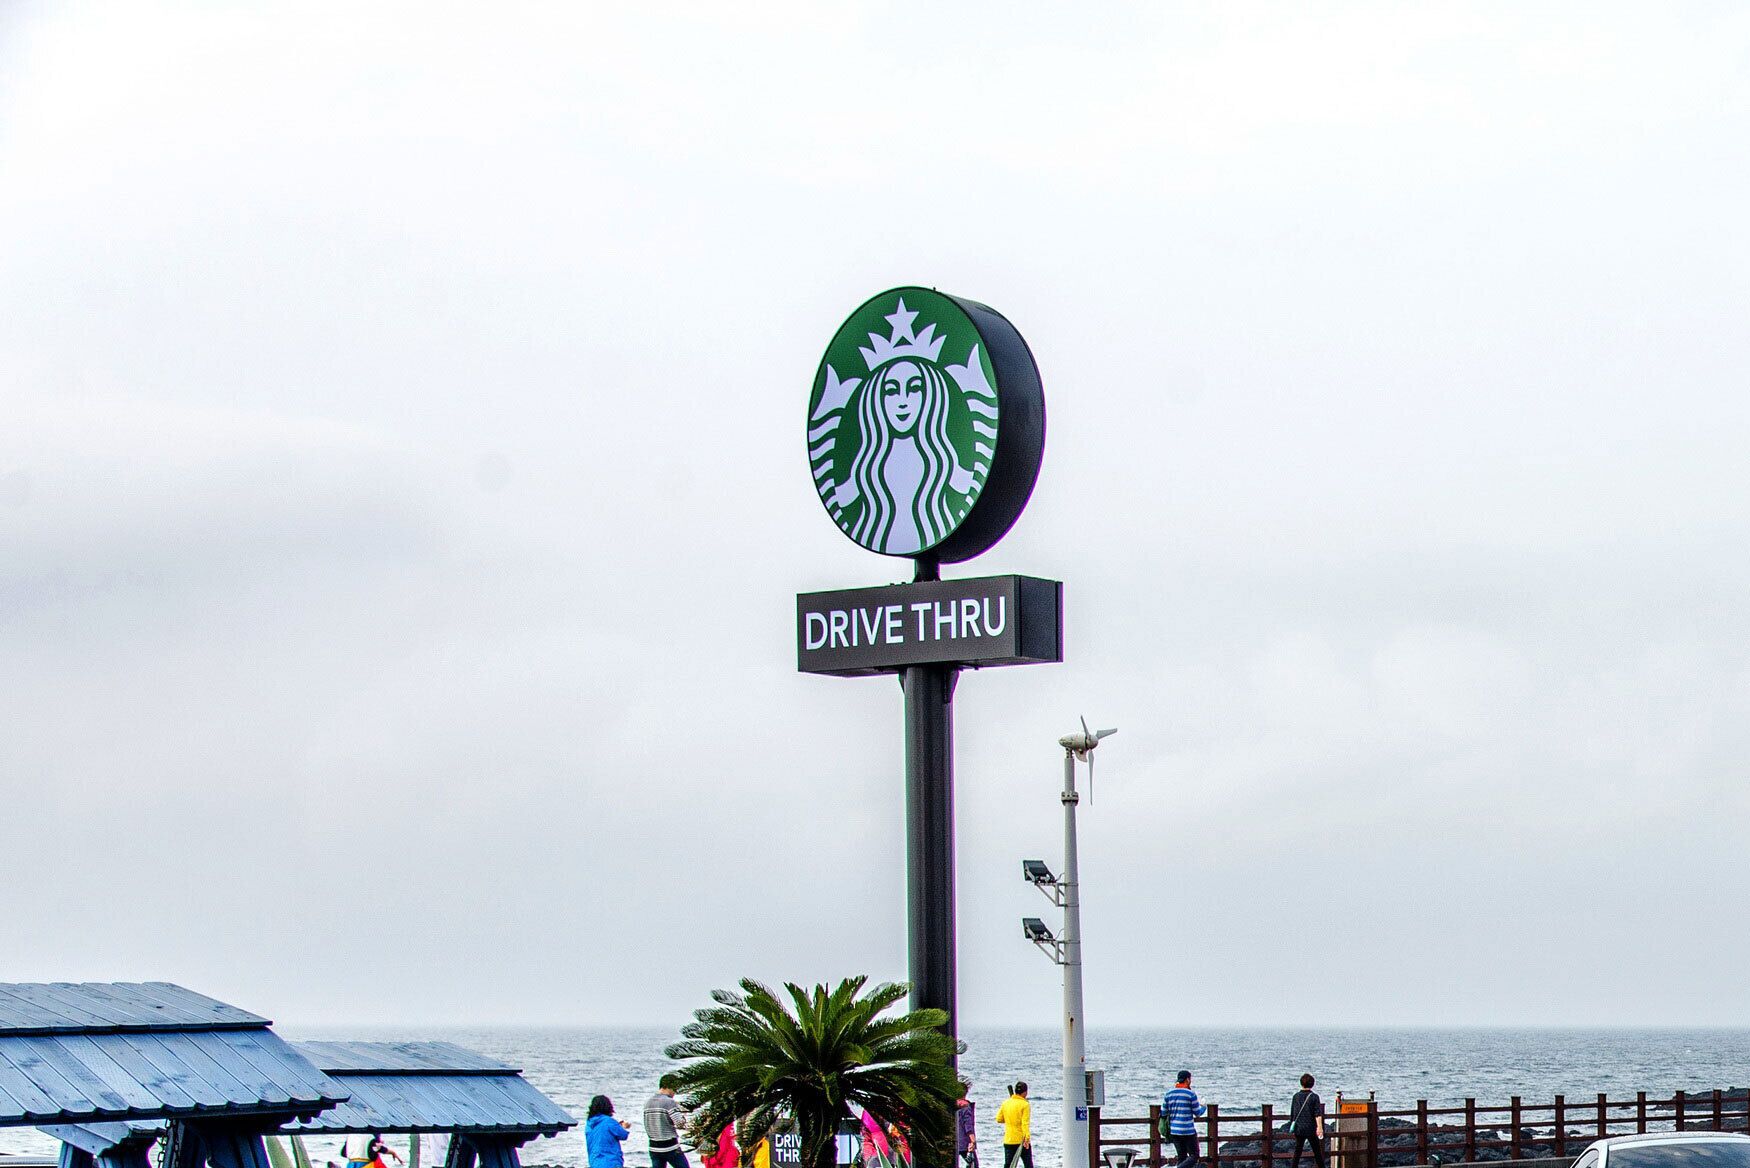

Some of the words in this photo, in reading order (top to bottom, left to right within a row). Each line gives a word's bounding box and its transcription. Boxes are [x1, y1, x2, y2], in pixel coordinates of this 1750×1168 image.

[805, 604, 904, 651] DRIVE
[910, 595, 1006, 643] THRU
[775, 1133, 803, 1148] DRIV
[775, 1148, 802, 1163] THR
